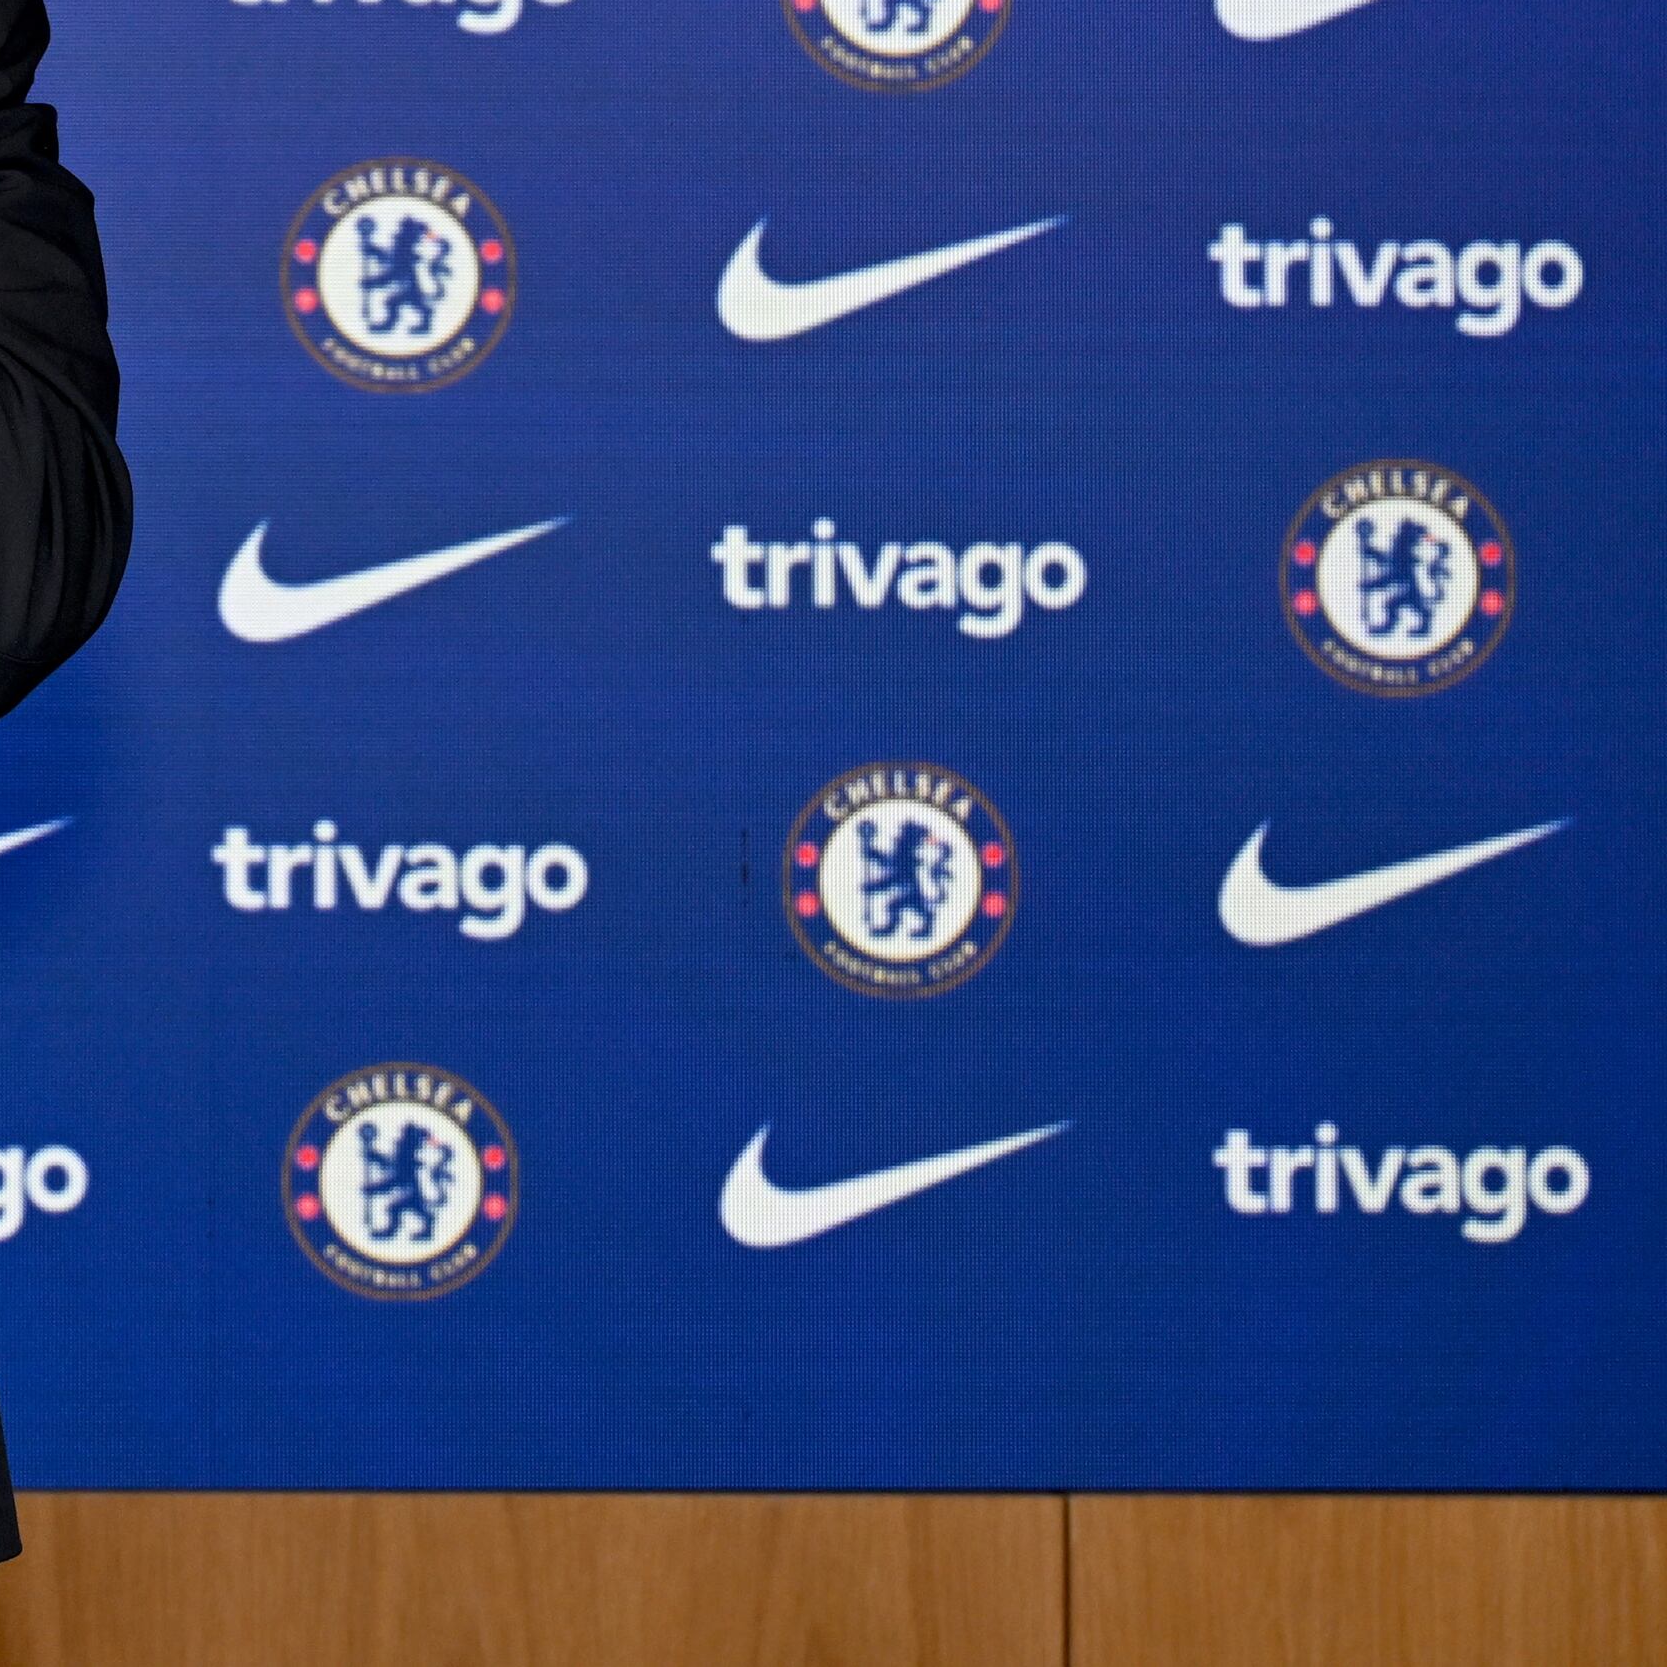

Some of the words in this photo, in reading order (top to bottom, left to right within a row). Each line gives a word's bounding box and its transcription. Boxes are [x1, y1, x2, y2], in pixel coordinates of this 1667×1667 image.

[322, 167, 472, 217] CHELSEA
[1211, 220, 1582, 335] trivago
[1321, 470, 1470, 520] CHELSEA
[713, 520, 1085, 637] trivago
[823, 771, 973, 821] CHELSEA
[214, 822, 587, 938] trivago
[324, 1073, 474, 1124] CHELSEA
[1216, 1125, 1588, 1241] trivago
